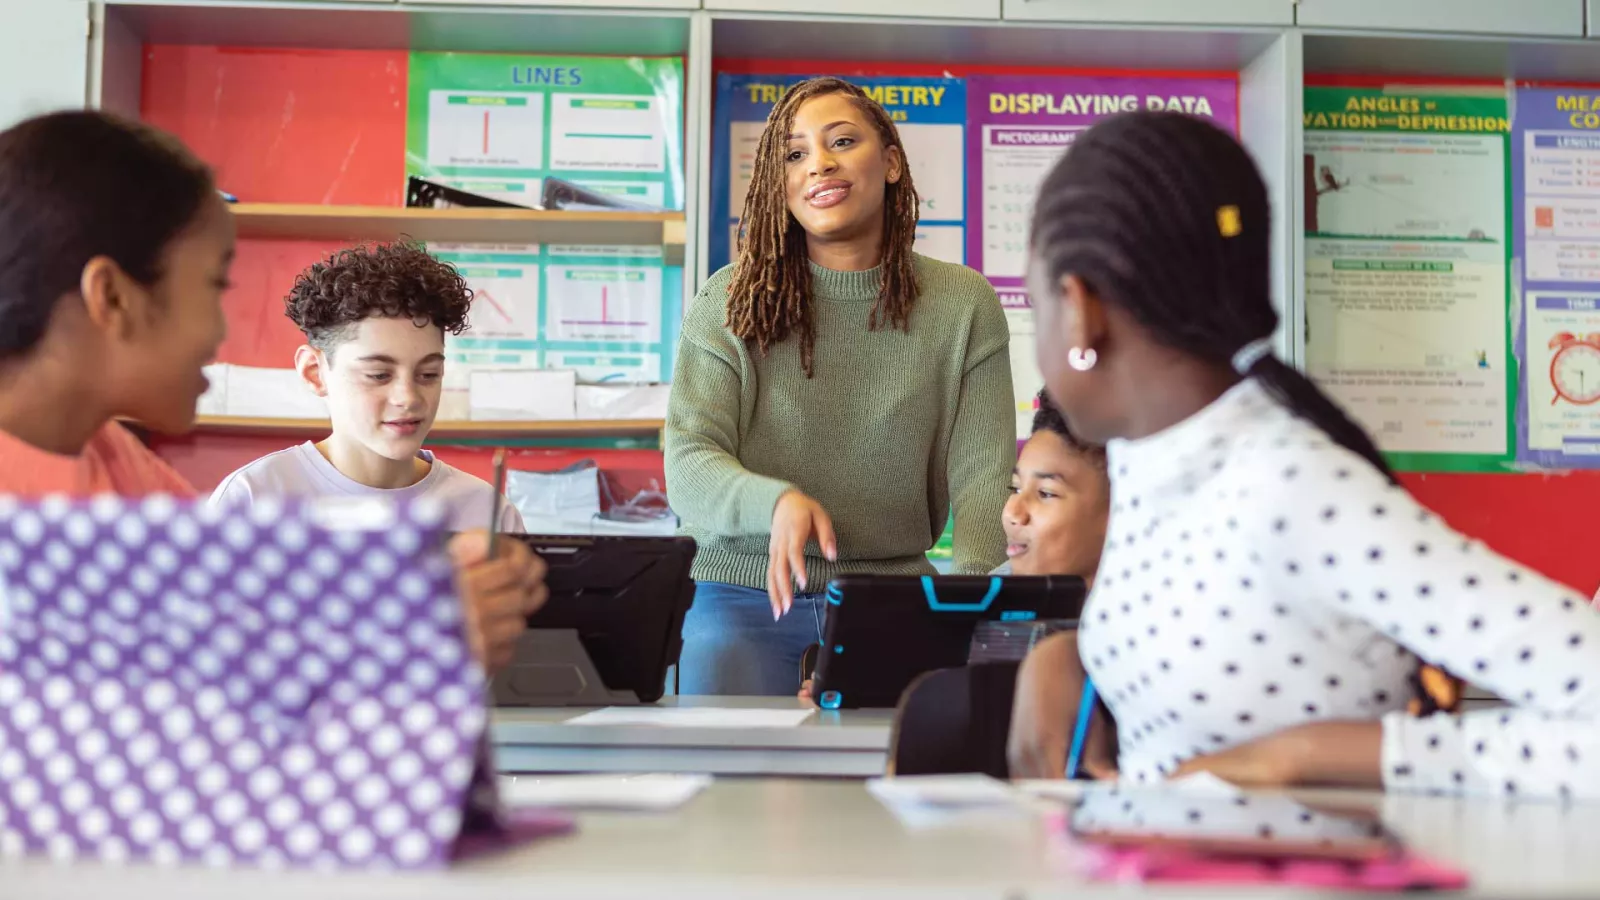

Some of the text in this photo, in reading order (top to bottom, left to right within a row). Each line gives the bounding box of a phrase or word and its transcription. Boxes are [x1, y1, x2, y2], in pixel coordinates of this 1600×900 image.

[512, 66, 583, 86] LINES
[748, 84, 945, 107] TRIMETRY
[989, 93, 1213, 116] DISPLAYING DATA
[1346, 96, 1419, 112] ANGLES
[1397, 114, 1512, 132] DEPRESSION
